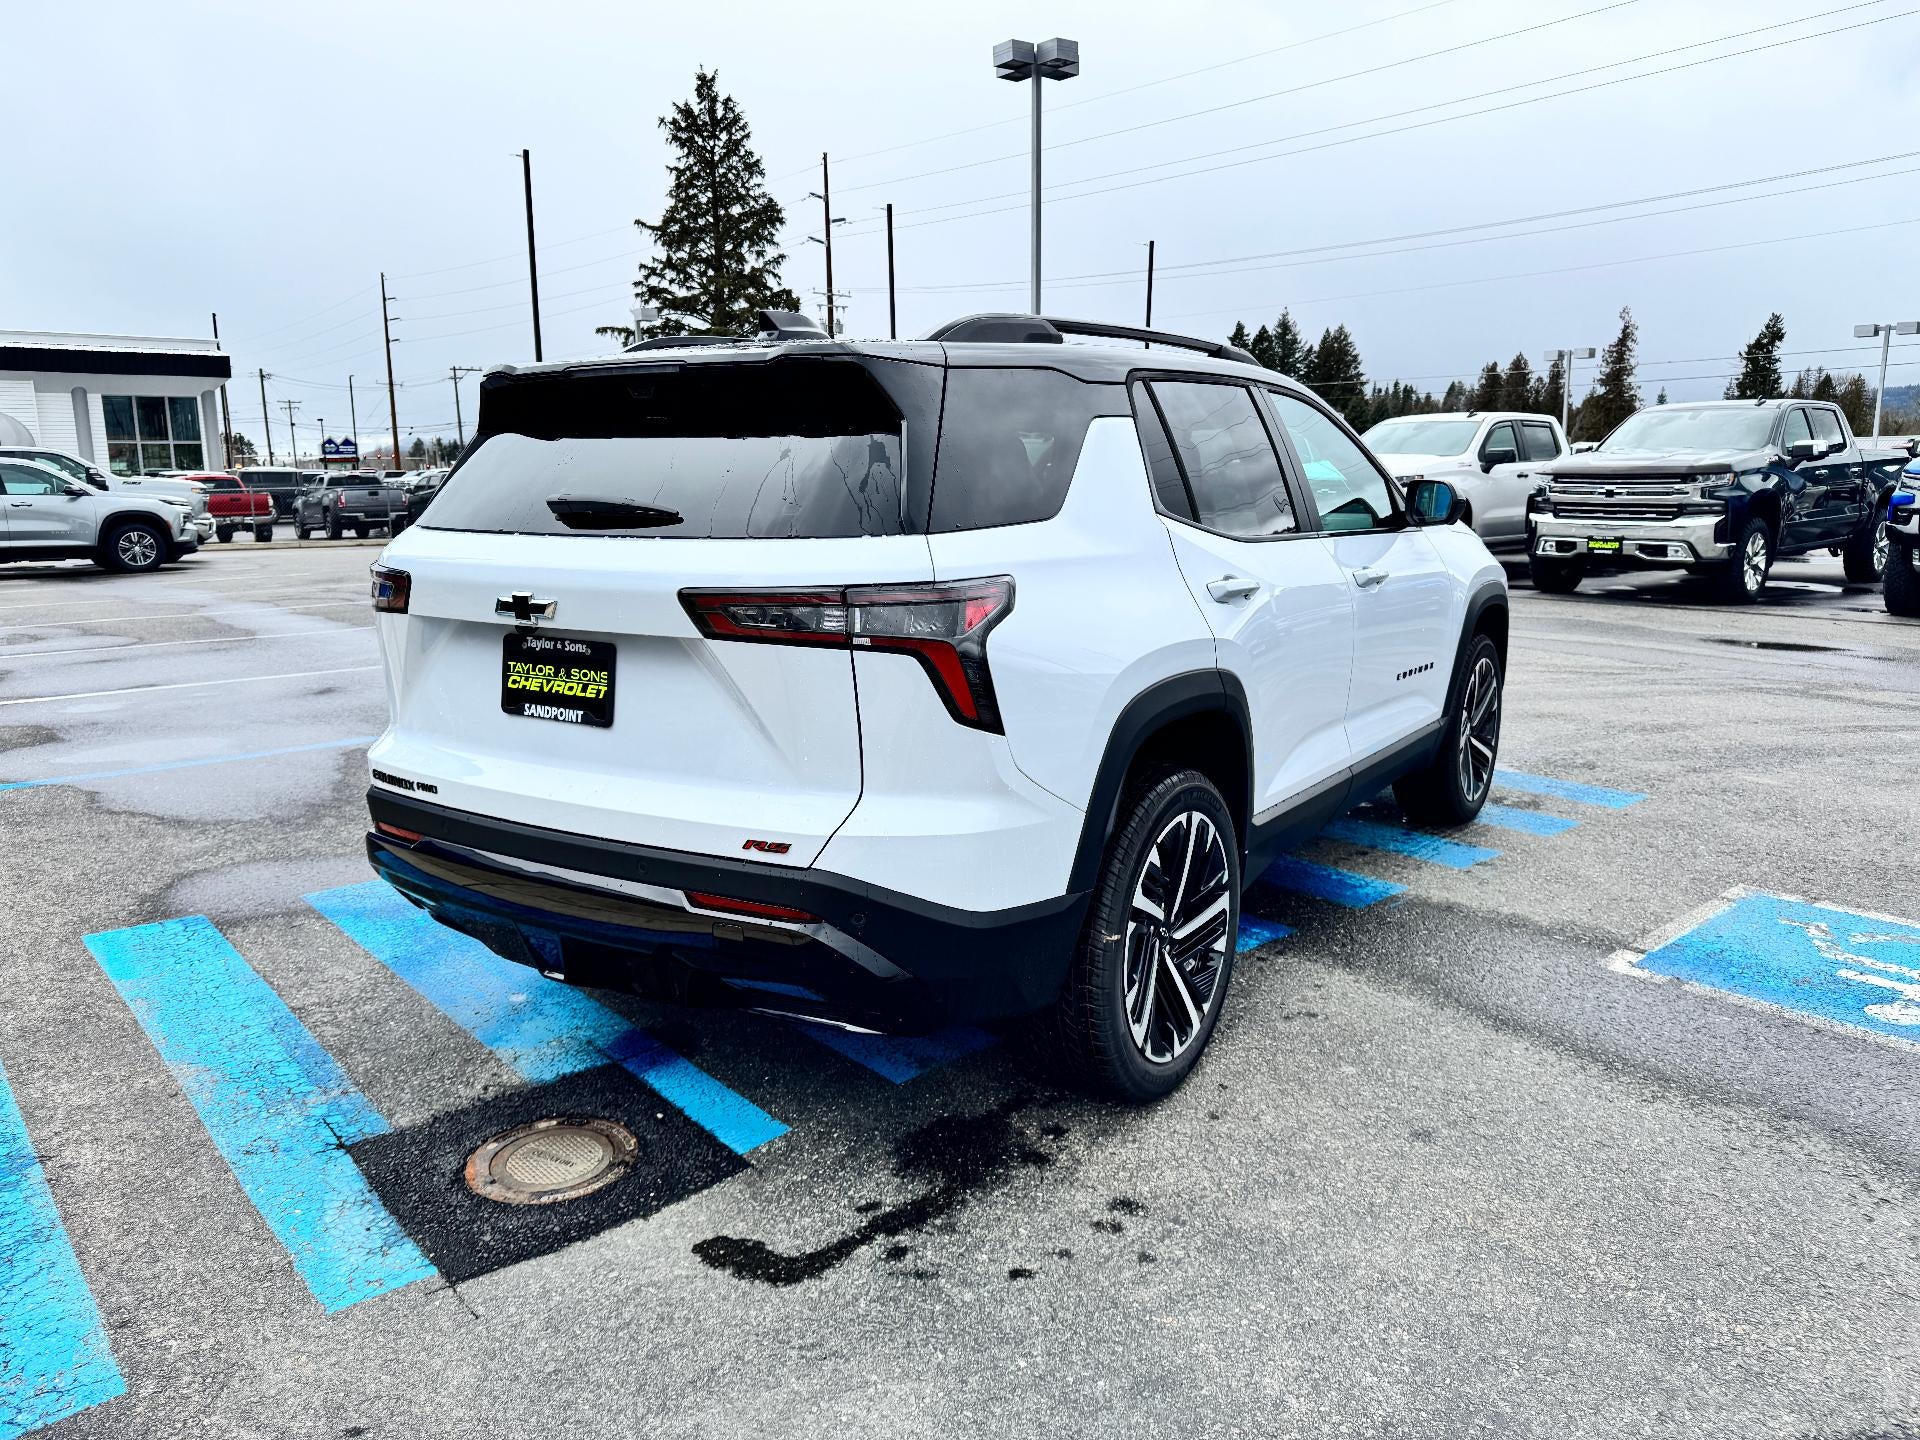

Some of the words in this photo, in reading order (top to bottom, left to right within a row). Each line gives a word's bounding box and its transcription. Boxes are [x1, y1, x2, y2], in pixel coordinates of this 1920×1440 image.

[526, 637, 555, 651] Taylor
[557, 641, 563, 649] &
[564, 641, 588, 654] Sons
[508, 662, 555, 677] TAYLOR
[559, 668, 567, 680] &
[571, 668, 608, 683] SONS
[507, 676, 608, 699] CHEVROLET
[524, 703, 584, 722] SANDPOINT
[742, 839, 793, 854] RS
